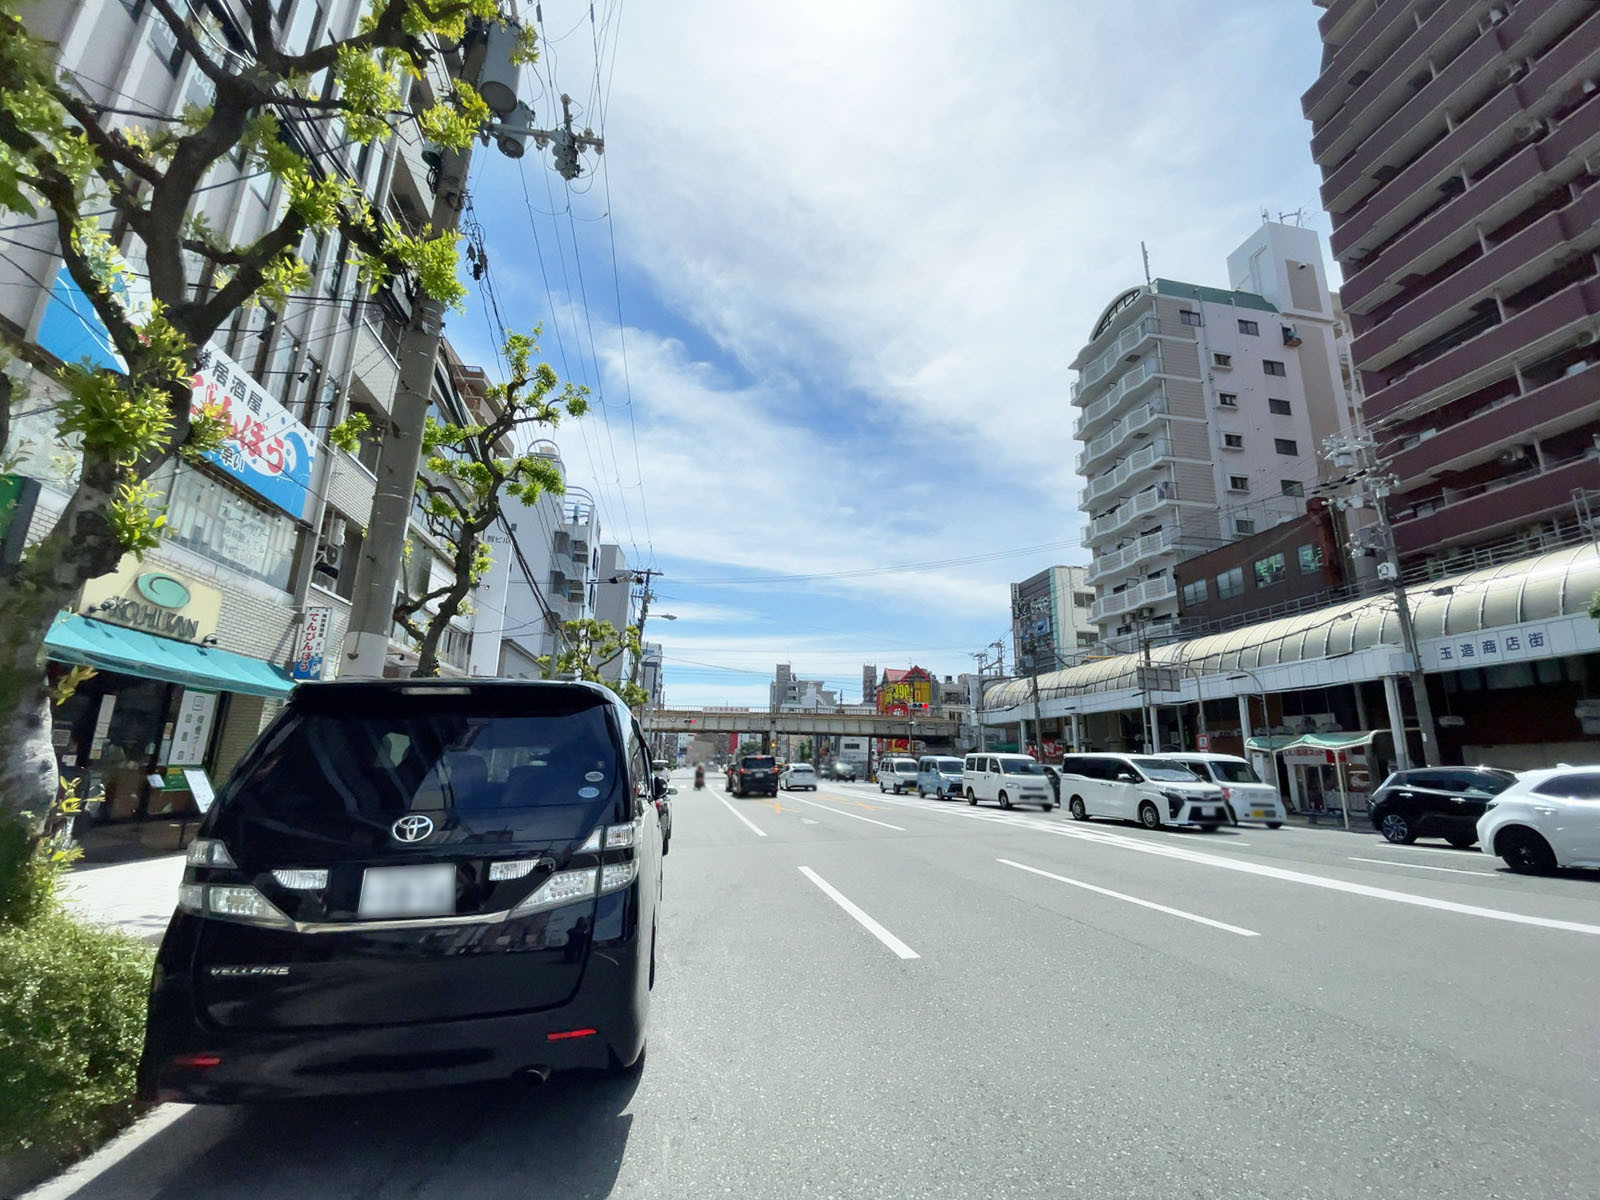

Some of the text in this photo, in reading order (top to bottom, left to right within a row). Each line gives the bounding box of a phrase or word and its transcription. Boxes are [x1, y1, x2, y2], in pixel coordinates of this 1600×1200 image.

[1440, 632, 1544, 660] 玉造商店街
